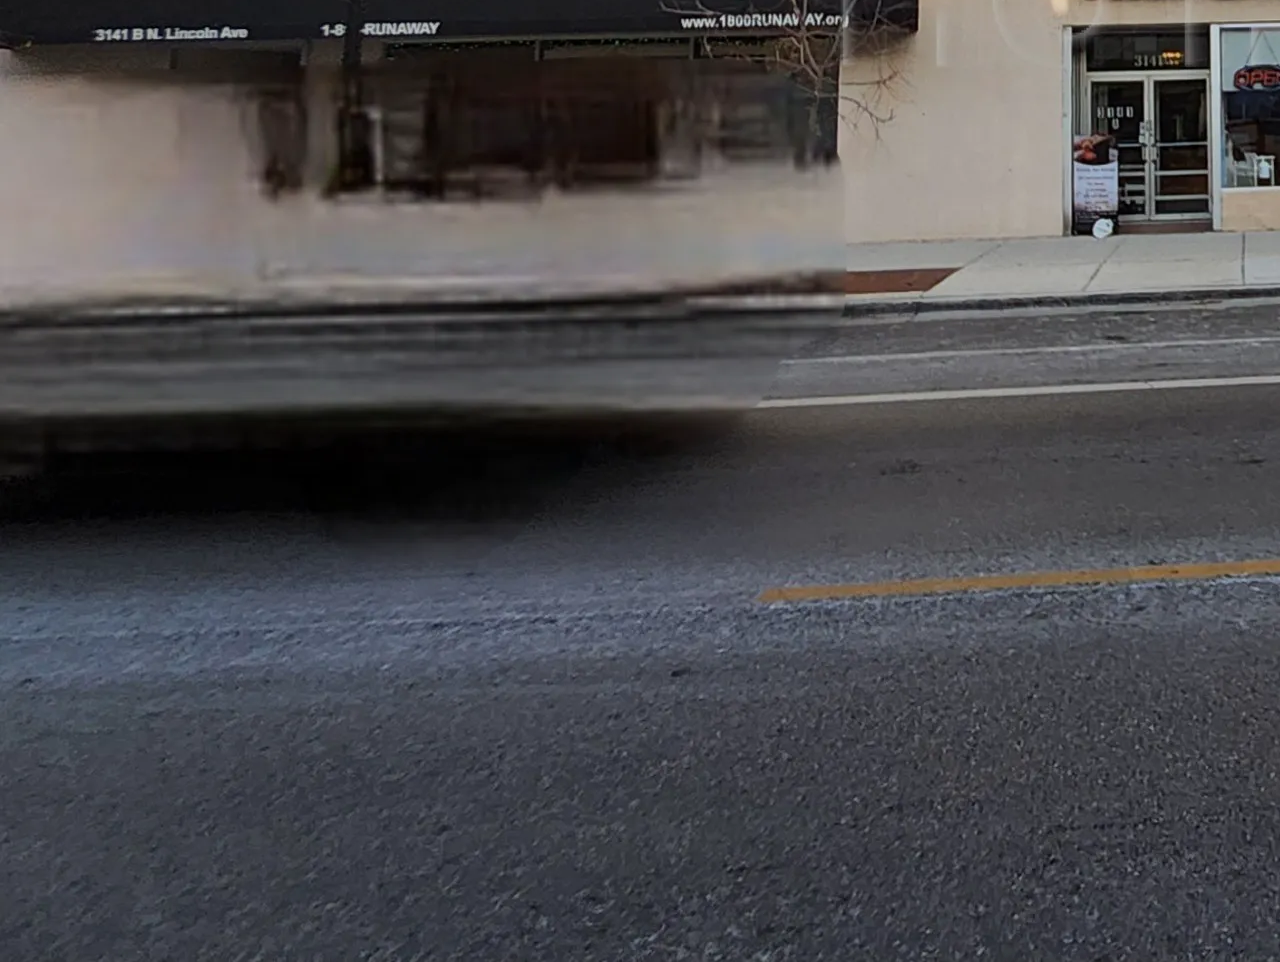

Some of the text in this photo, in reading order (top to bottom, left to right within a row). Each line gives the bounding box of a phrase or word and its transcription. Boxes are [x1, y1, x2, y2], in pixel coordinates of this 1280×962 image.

[94, 26, 248, 41] 3141 B N. Lincoln Ave
[321, 22, 441, 37] 1-8-RUNAWAY
